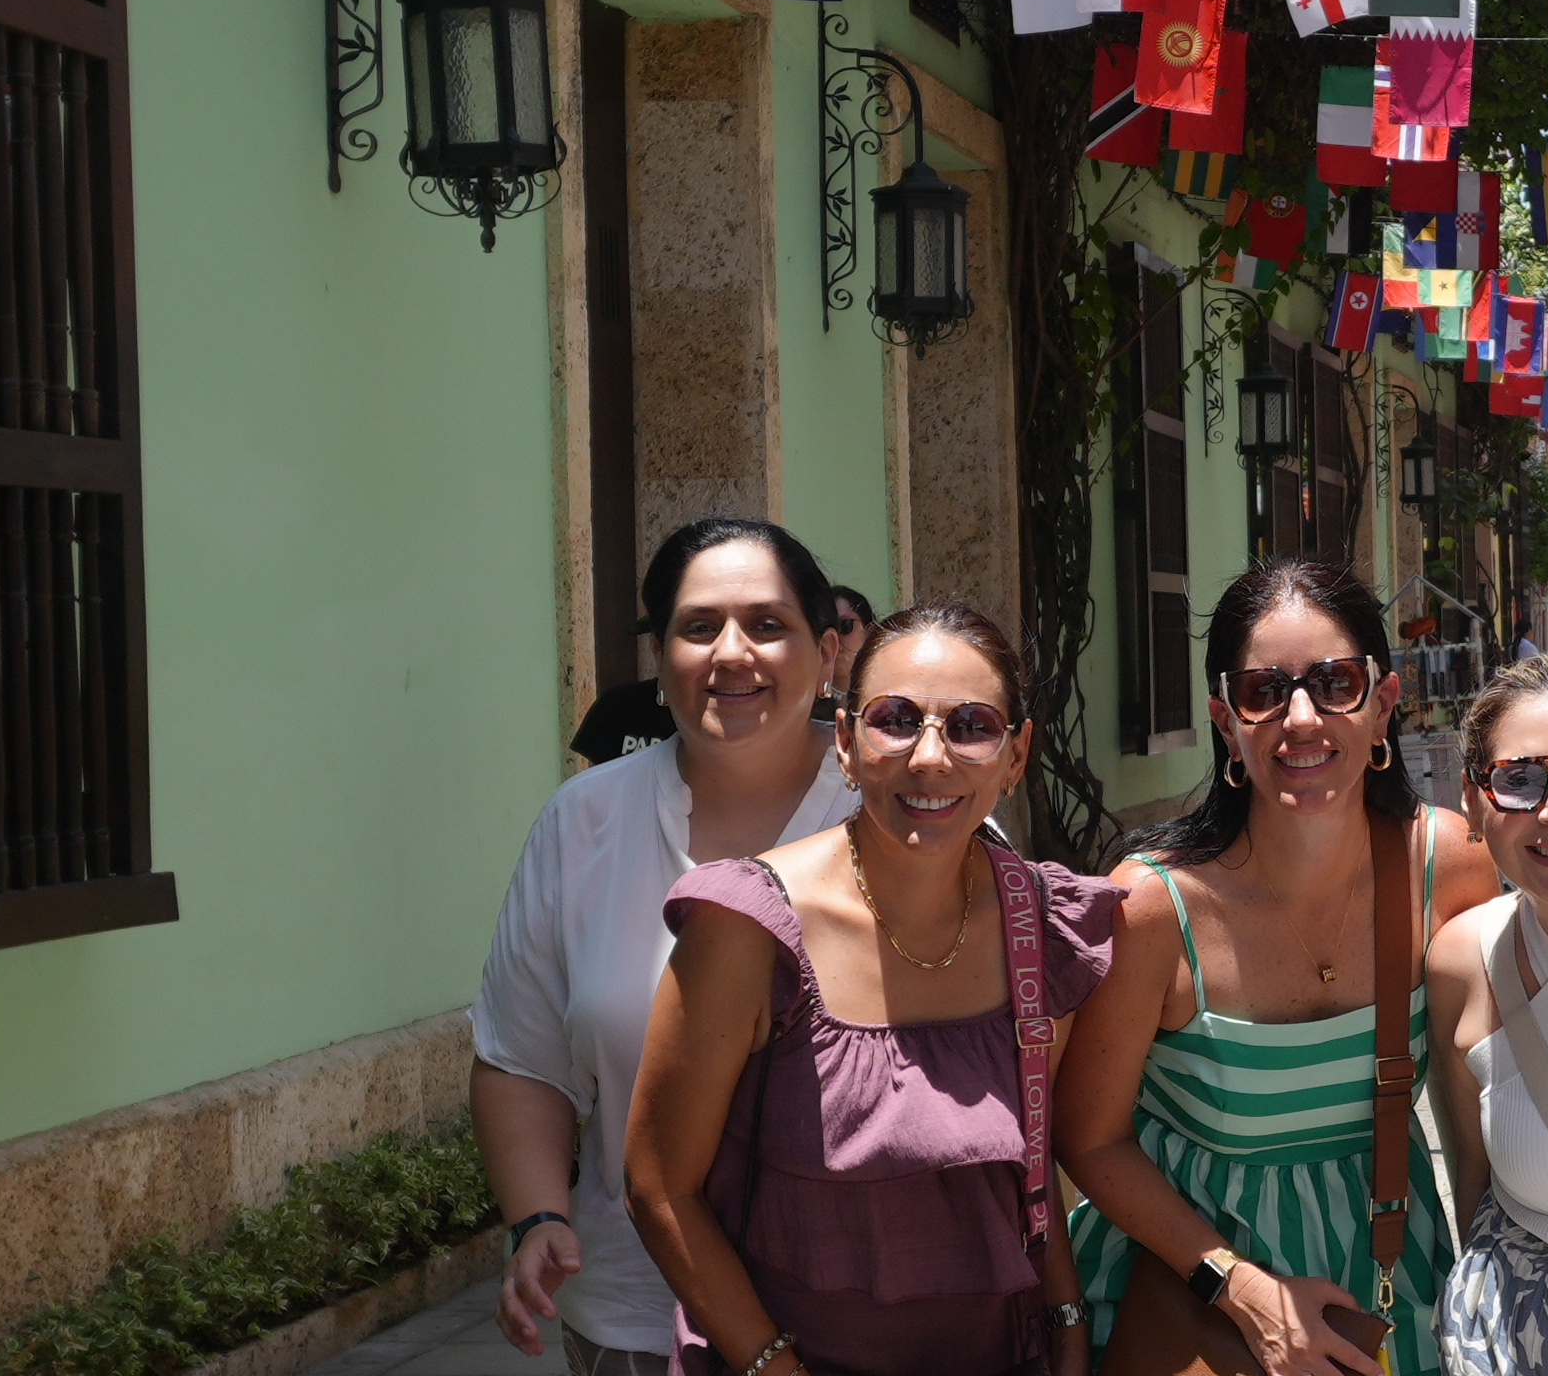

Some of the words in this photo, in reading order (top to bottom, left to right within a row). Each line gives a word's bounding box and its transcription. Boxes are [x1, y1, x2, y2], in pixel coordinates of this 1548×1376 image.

[999, 861, 1038, 952] LOEWE
[1015, 967, 1048, 1059] LOEWE
[1026, 1073, 1046, 1170] LOEWE
